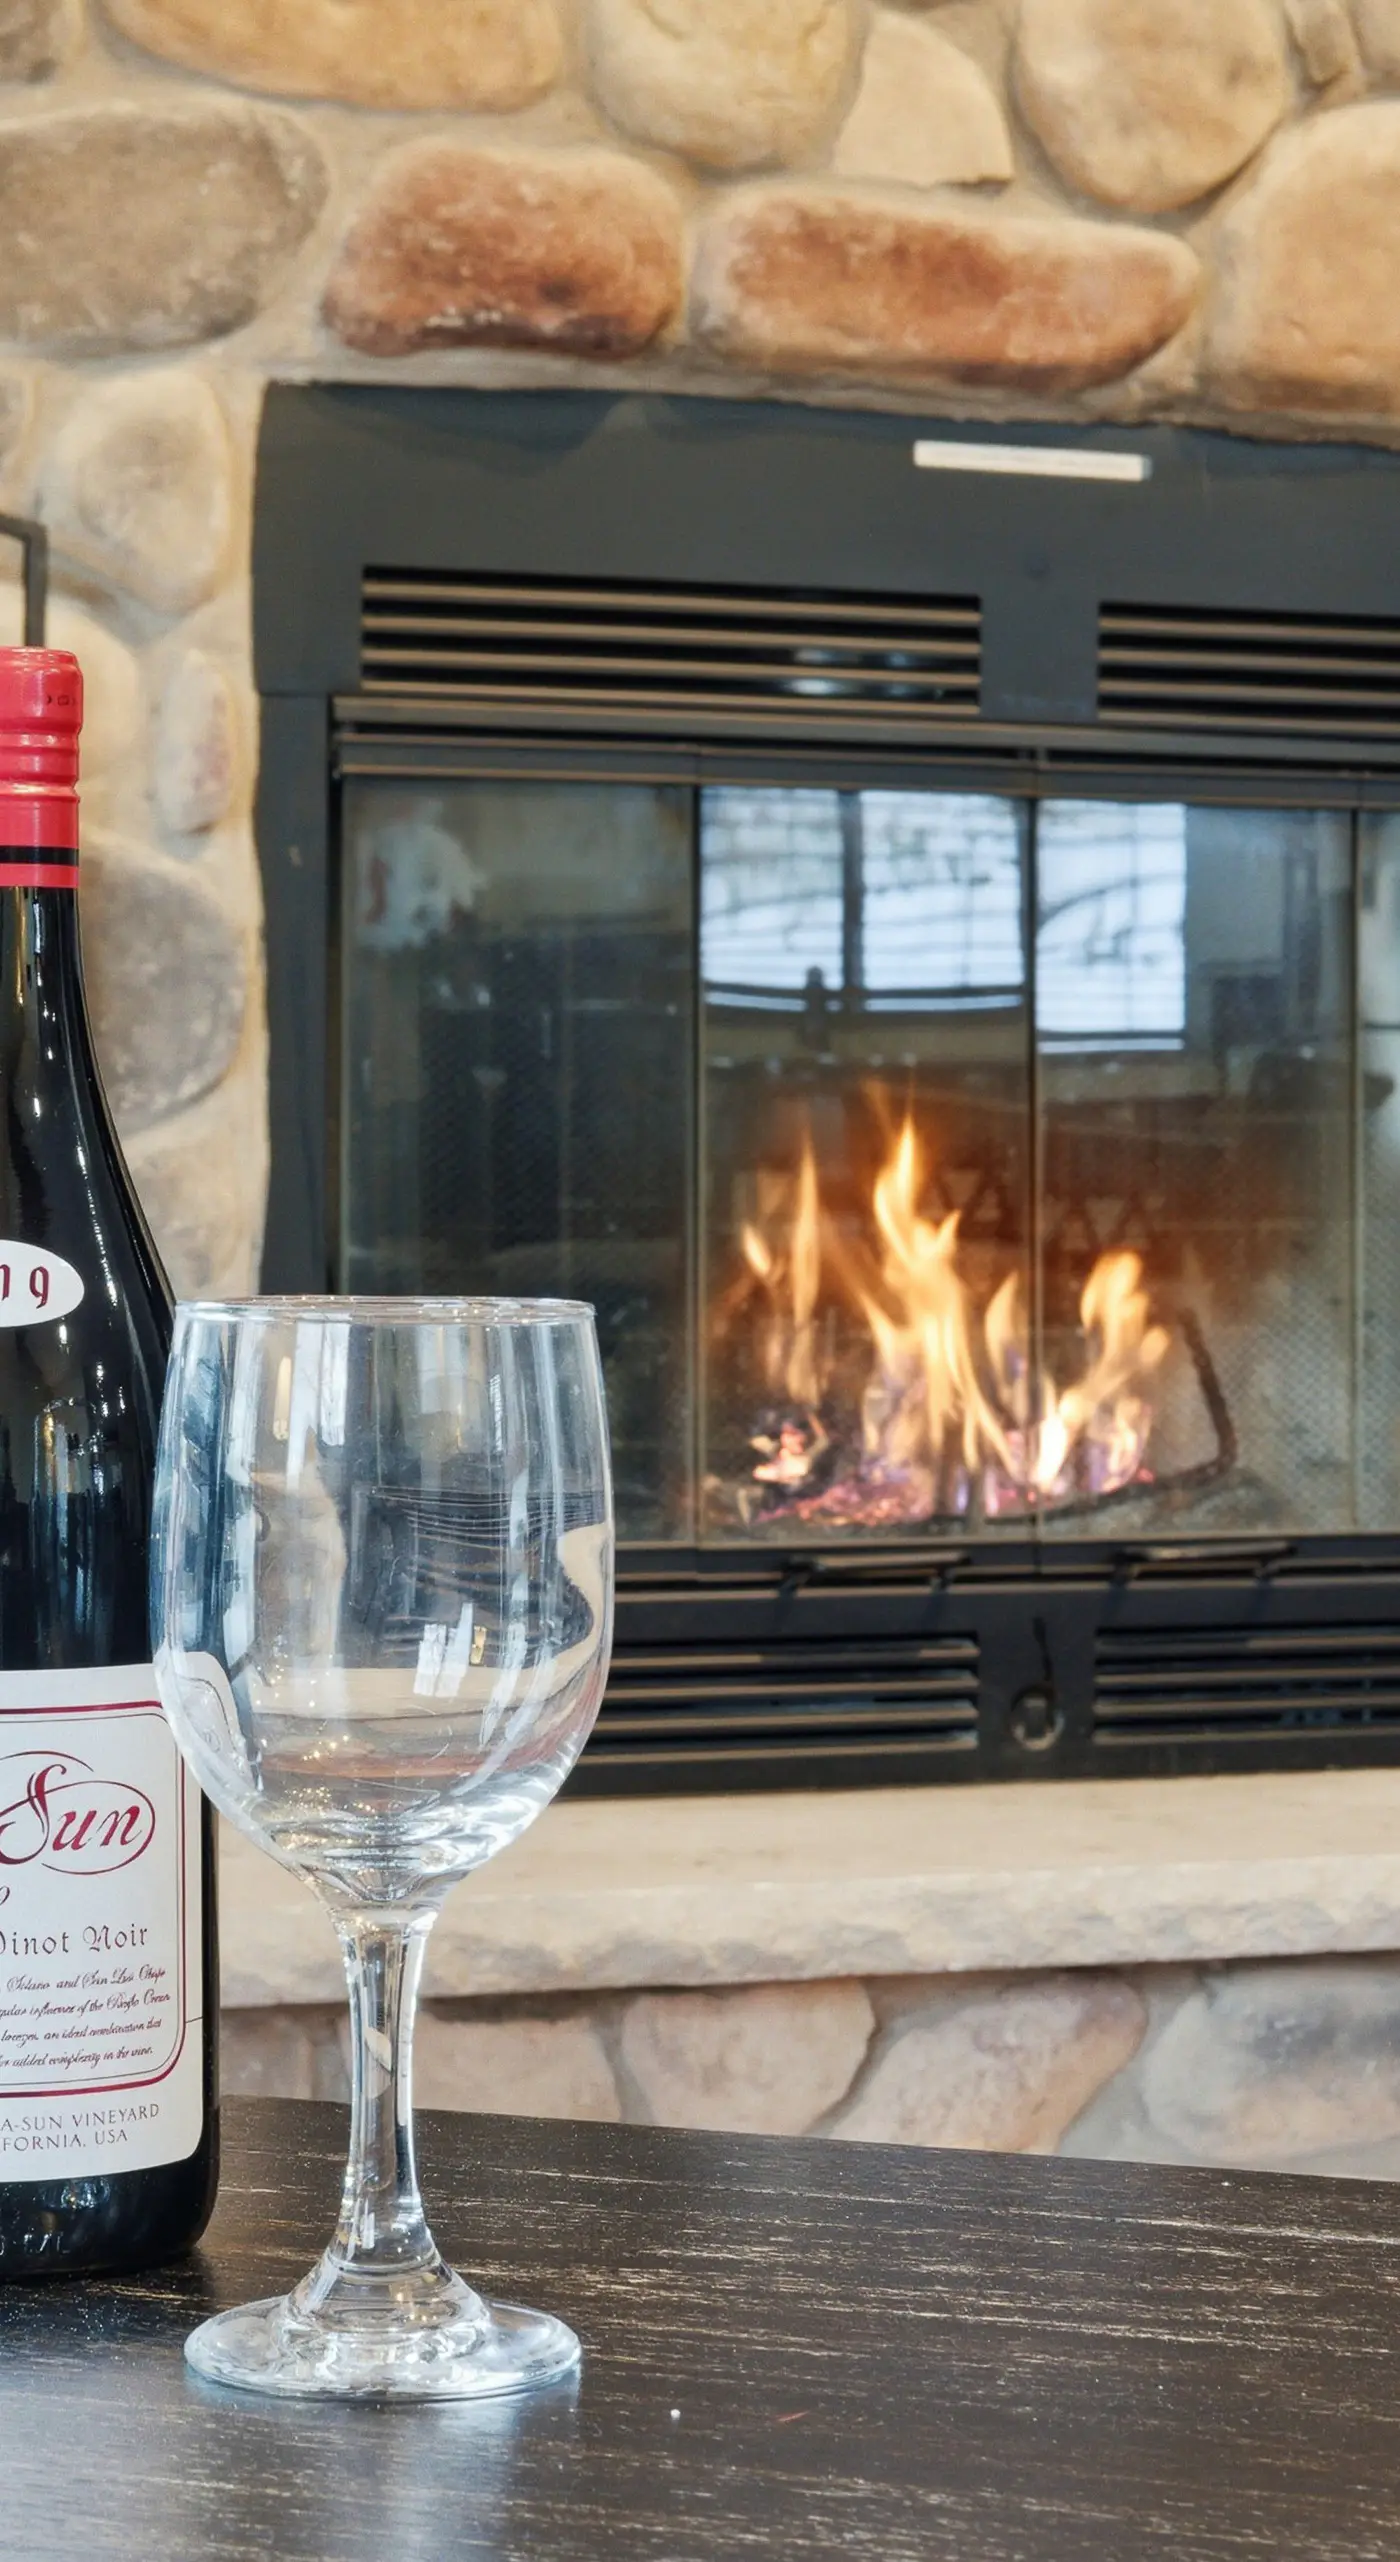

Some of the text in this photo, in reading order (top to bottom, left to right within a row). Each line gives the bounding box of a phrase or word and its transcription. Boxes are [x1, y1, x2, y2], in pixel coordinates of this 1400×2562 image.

[82, 1923, 148, 1952] Noir
[56, 1974, 80, 1989] and
[71, 2103, 160, 2128] VINEYARD
[95, 2128, 128, 2146] USA
